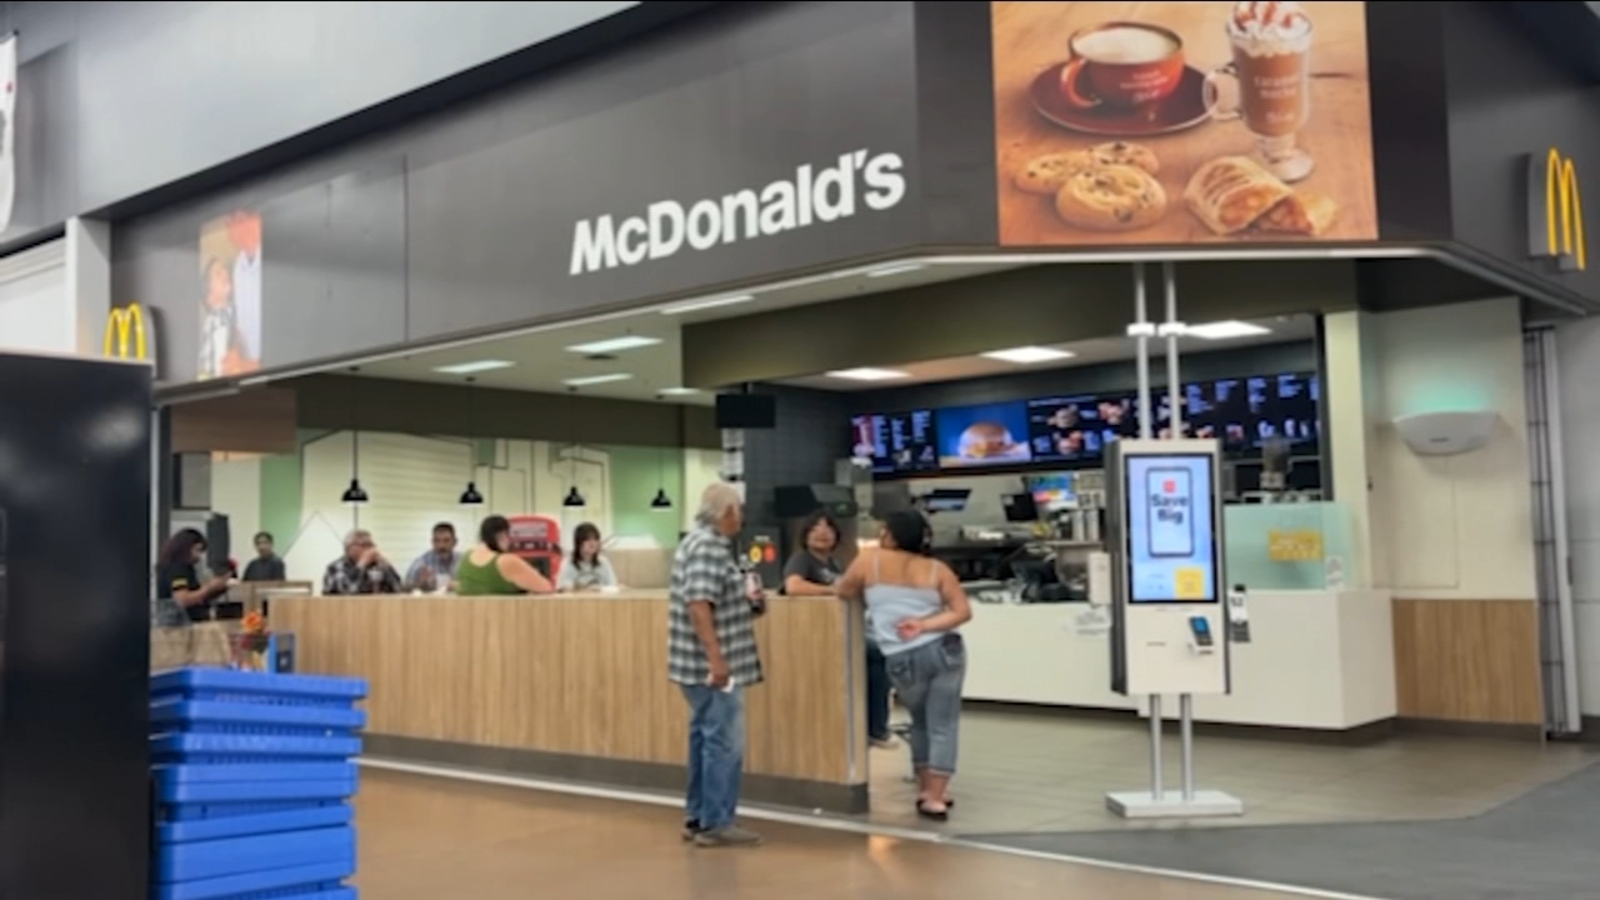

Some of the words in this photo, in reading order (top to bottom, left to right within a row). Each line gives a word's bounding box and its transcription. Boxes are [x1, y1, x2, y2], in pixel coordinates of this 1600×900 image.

[569, 148, 906, 276] McDonald's
[1150, 493, 1189, 507] Save
[1157, 508, 1184, 526] Big
